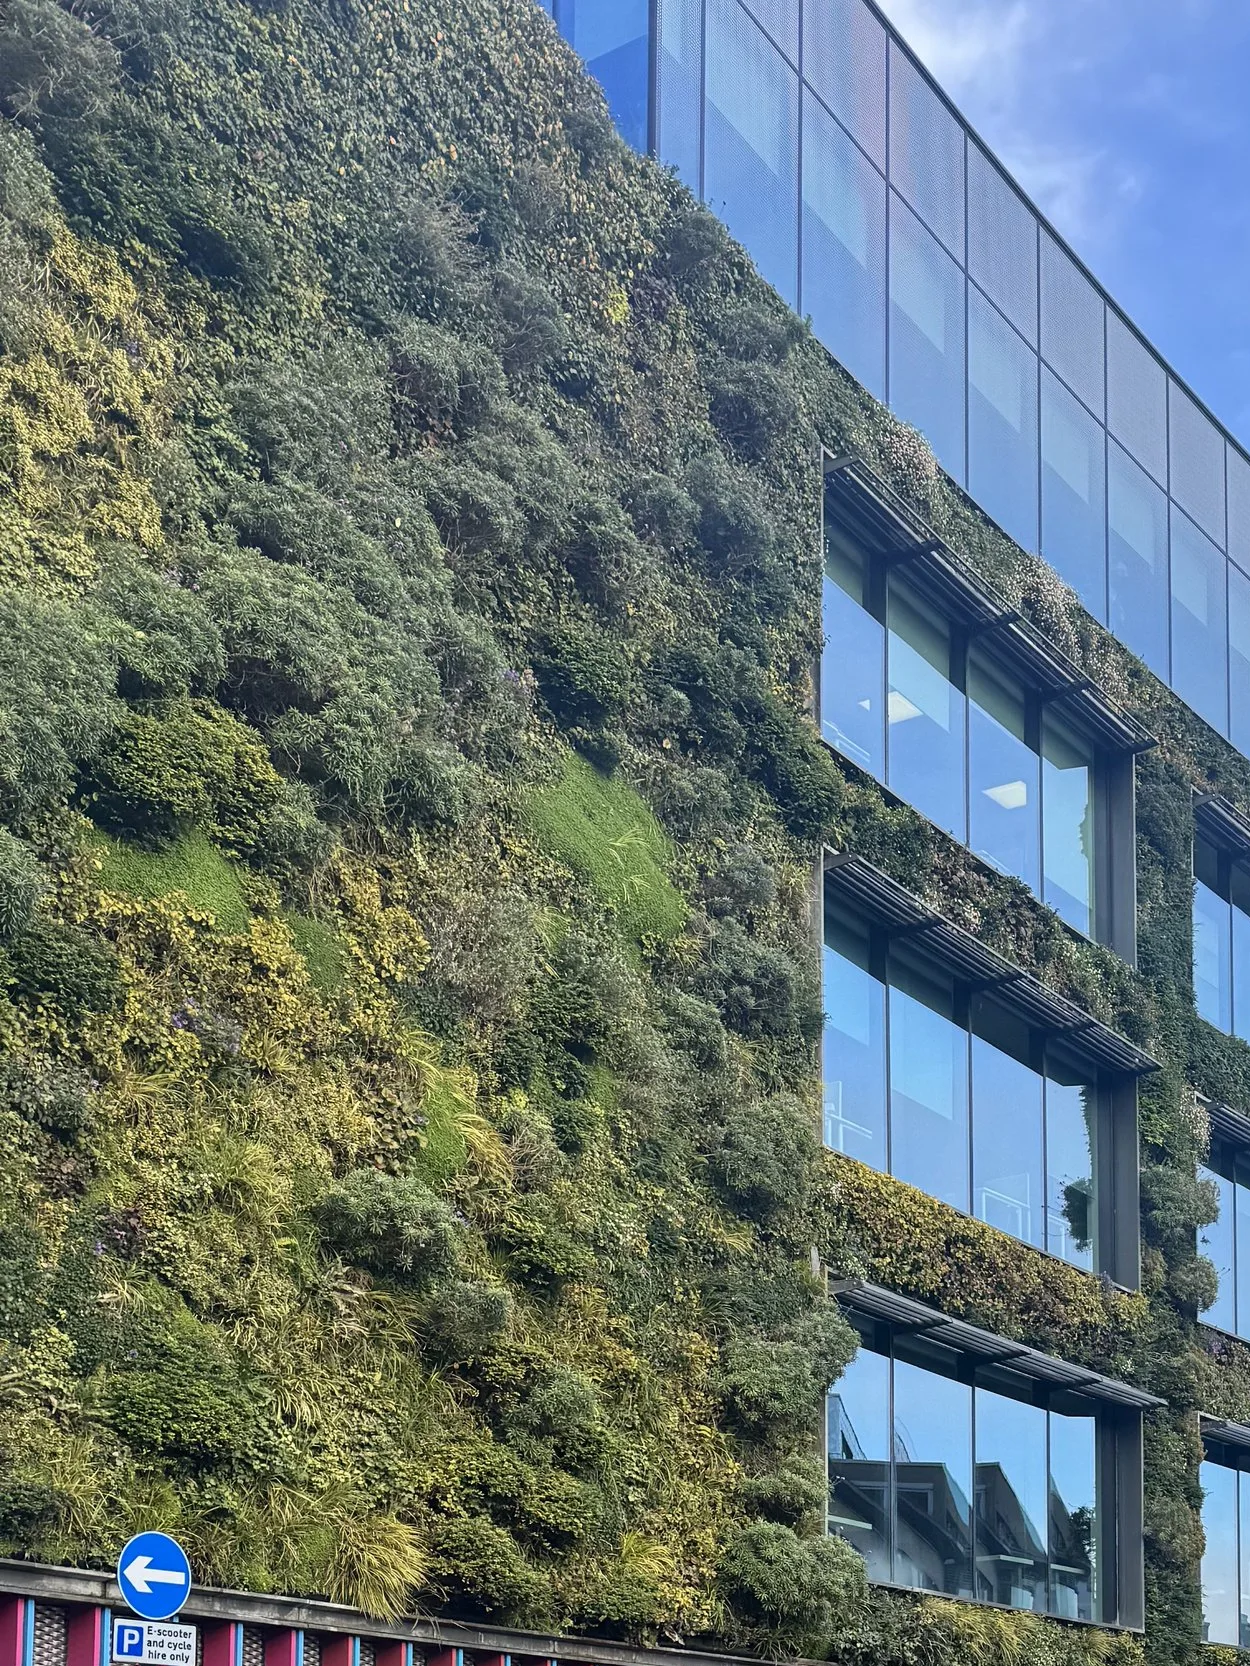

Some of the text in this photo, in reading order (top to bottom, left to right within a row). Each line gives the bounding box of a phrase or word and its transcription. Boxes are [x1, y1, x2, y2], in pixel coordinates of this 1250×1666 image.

[147, 1626, 192, 1639] E-scooter
[123, 1628, 140, 1653] P
[146, 1639, 192, 1652] and cycle
[148, 1650, 190, 1664] hire only
